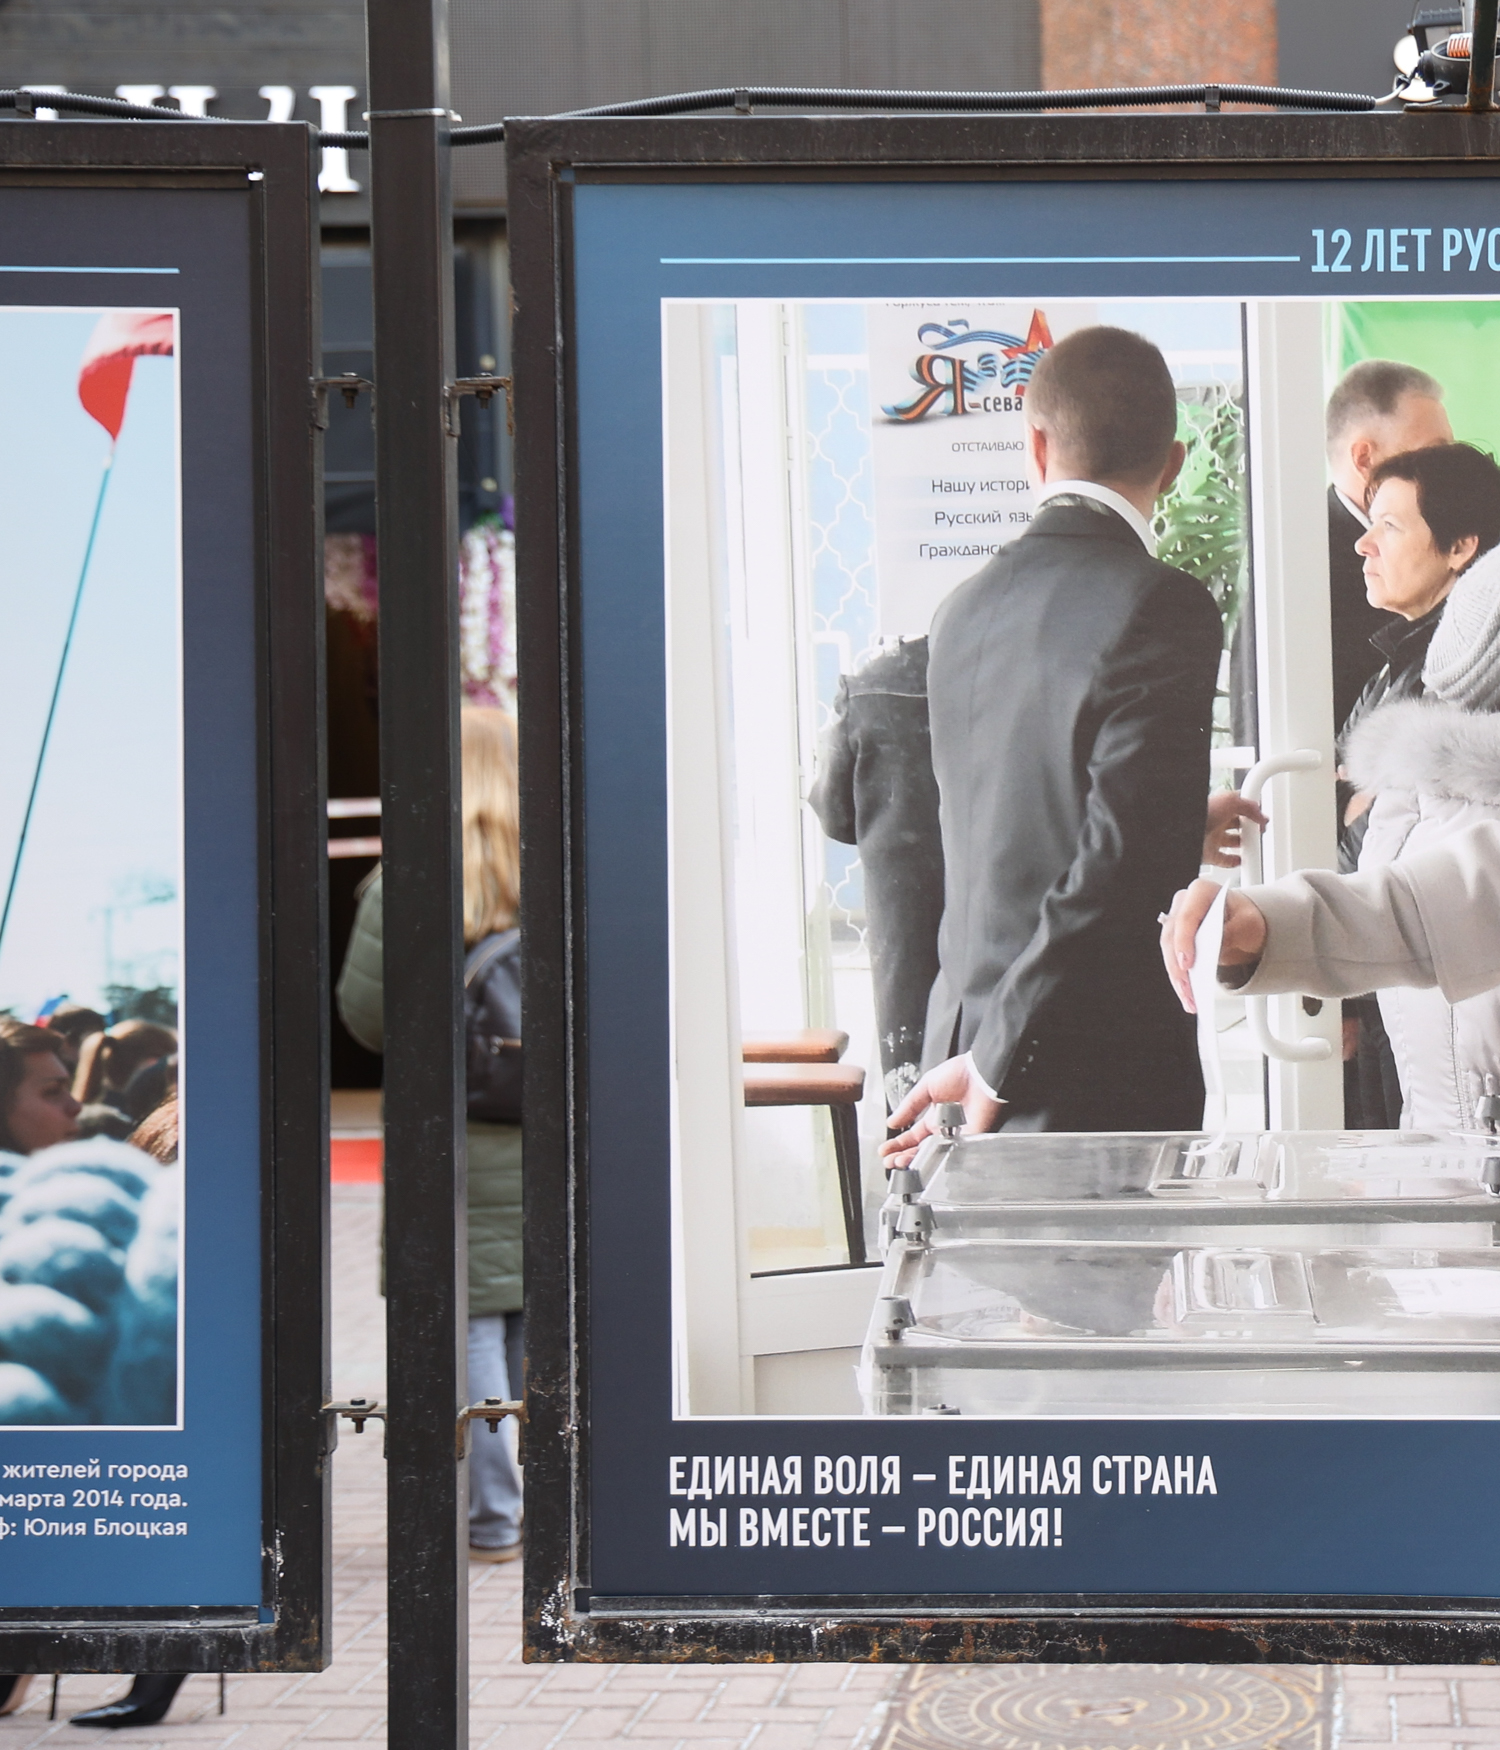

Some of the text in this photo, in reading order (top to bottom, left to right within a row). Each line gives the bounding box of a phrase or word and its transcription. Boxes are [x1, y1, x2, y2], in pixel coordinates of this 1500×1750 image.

[1311, 228, 1352, 273] 12
[1360, 228, 1432, 273] ЛЕТ
[931, 479, 976, 495] Нашу
[934, 510, 1002, 527] Русский
[919, 543, 1003, 560] Гражданс
[3, 1458, 189, 1483] жителей города
[669, 1455, 802, 1501] ЕДИНАЯ
[814, 1455, 901, 1496] ВОЛЯ
[948, 1455, 1081, 1500] ЕДИНАЯ
[1092, 1455, 1218, 1495] СТРАНА
[72, 1489, 125, 1508] 2014
[130, 1493, 188, 1511] года.
[24, 1517, 87, 1536] Юлия
[94, 1518, 188, 1539] Блоцкая
[669, 1507, 727, 1547] МЫ
[739, 1507, 871, 1547] ВМЕСТЕ
[917, 1507, 1063, 1547] РОССИЯ!
